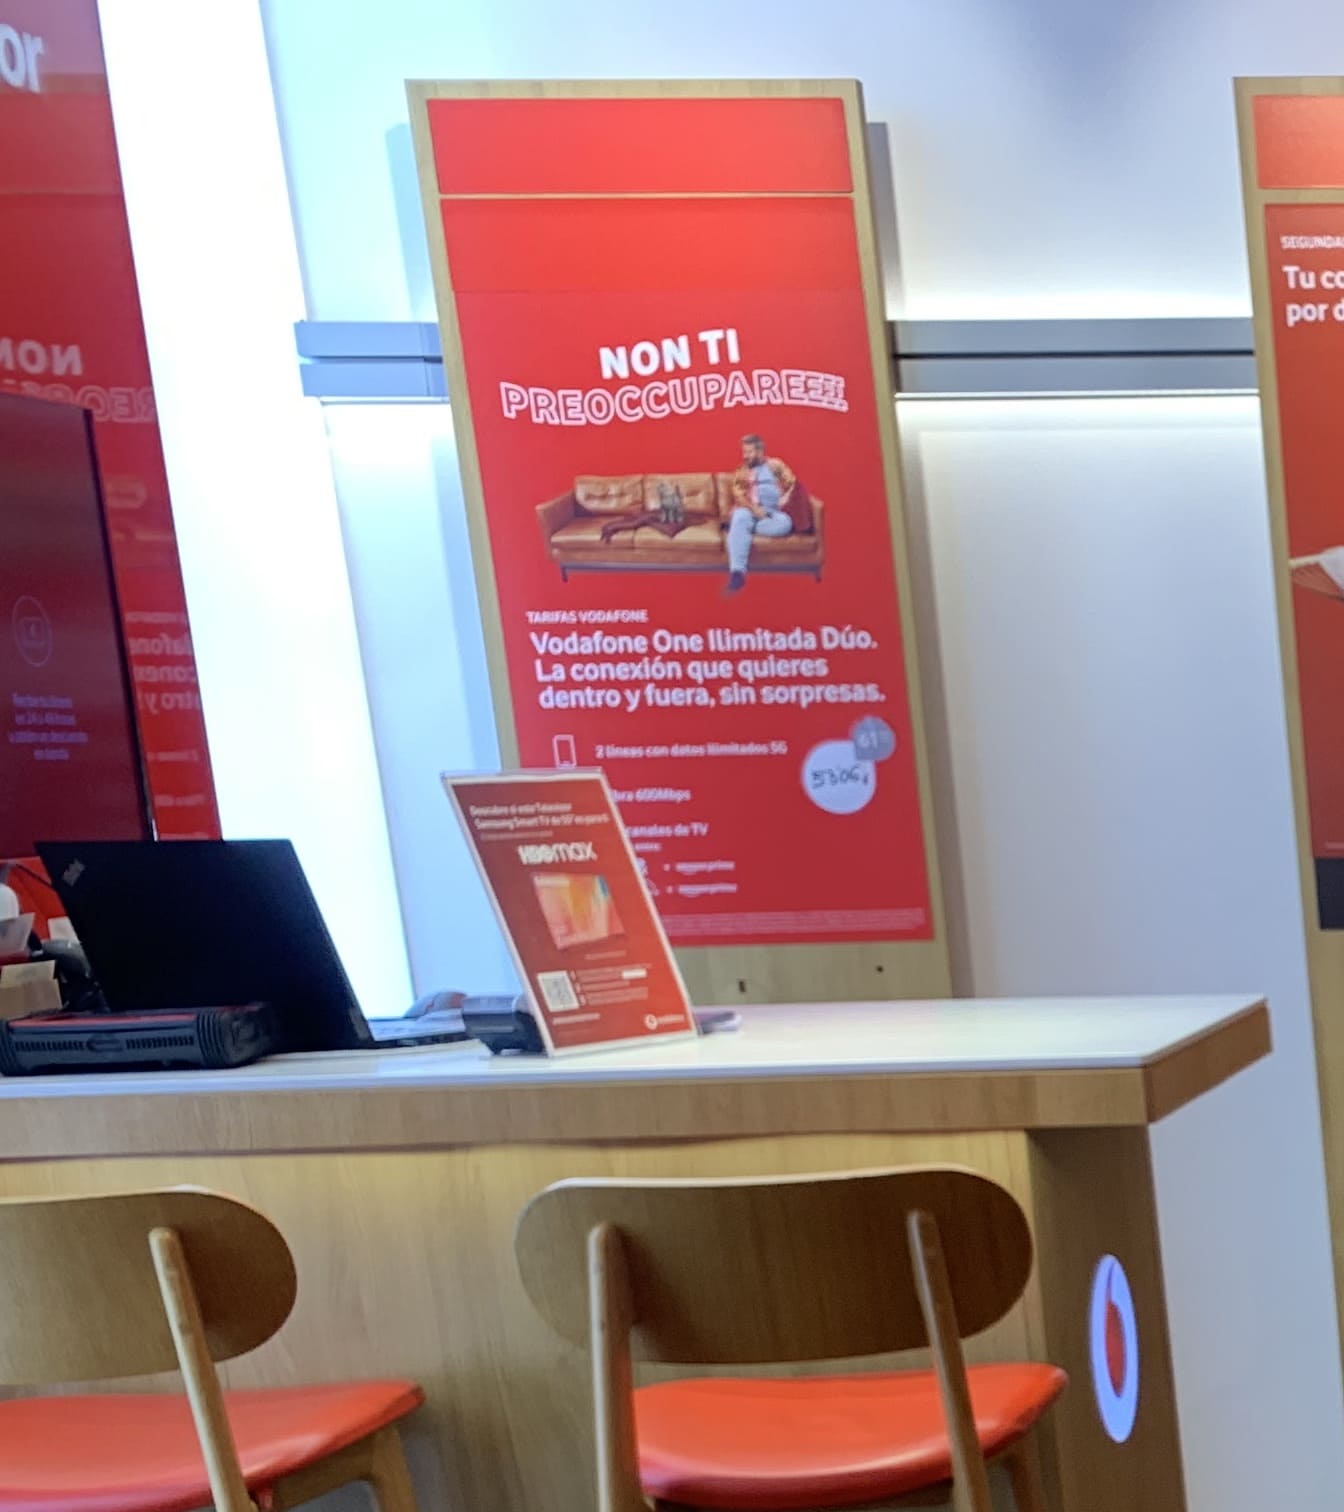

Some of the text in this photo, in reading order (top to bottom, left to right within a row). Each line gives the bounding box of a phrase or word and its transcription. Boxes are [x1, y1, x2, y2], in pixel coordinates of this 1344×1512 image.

[1282, 266, 1315, 290] Tu
[1287, 302, 1328, 327] por
[599, 329, 740, 379] NON TI
[527, 610, 648, 624] TARIFAS VODAFONE
[530, 625, 877, 656] Vodafone One Ilimitada Dúo.
[536, 656, 828, 683] La conexión que quieres
[539, 683, 886, 712] dentro y fuera, sin sorpresas.
[690, 822, 709, 836] TV
